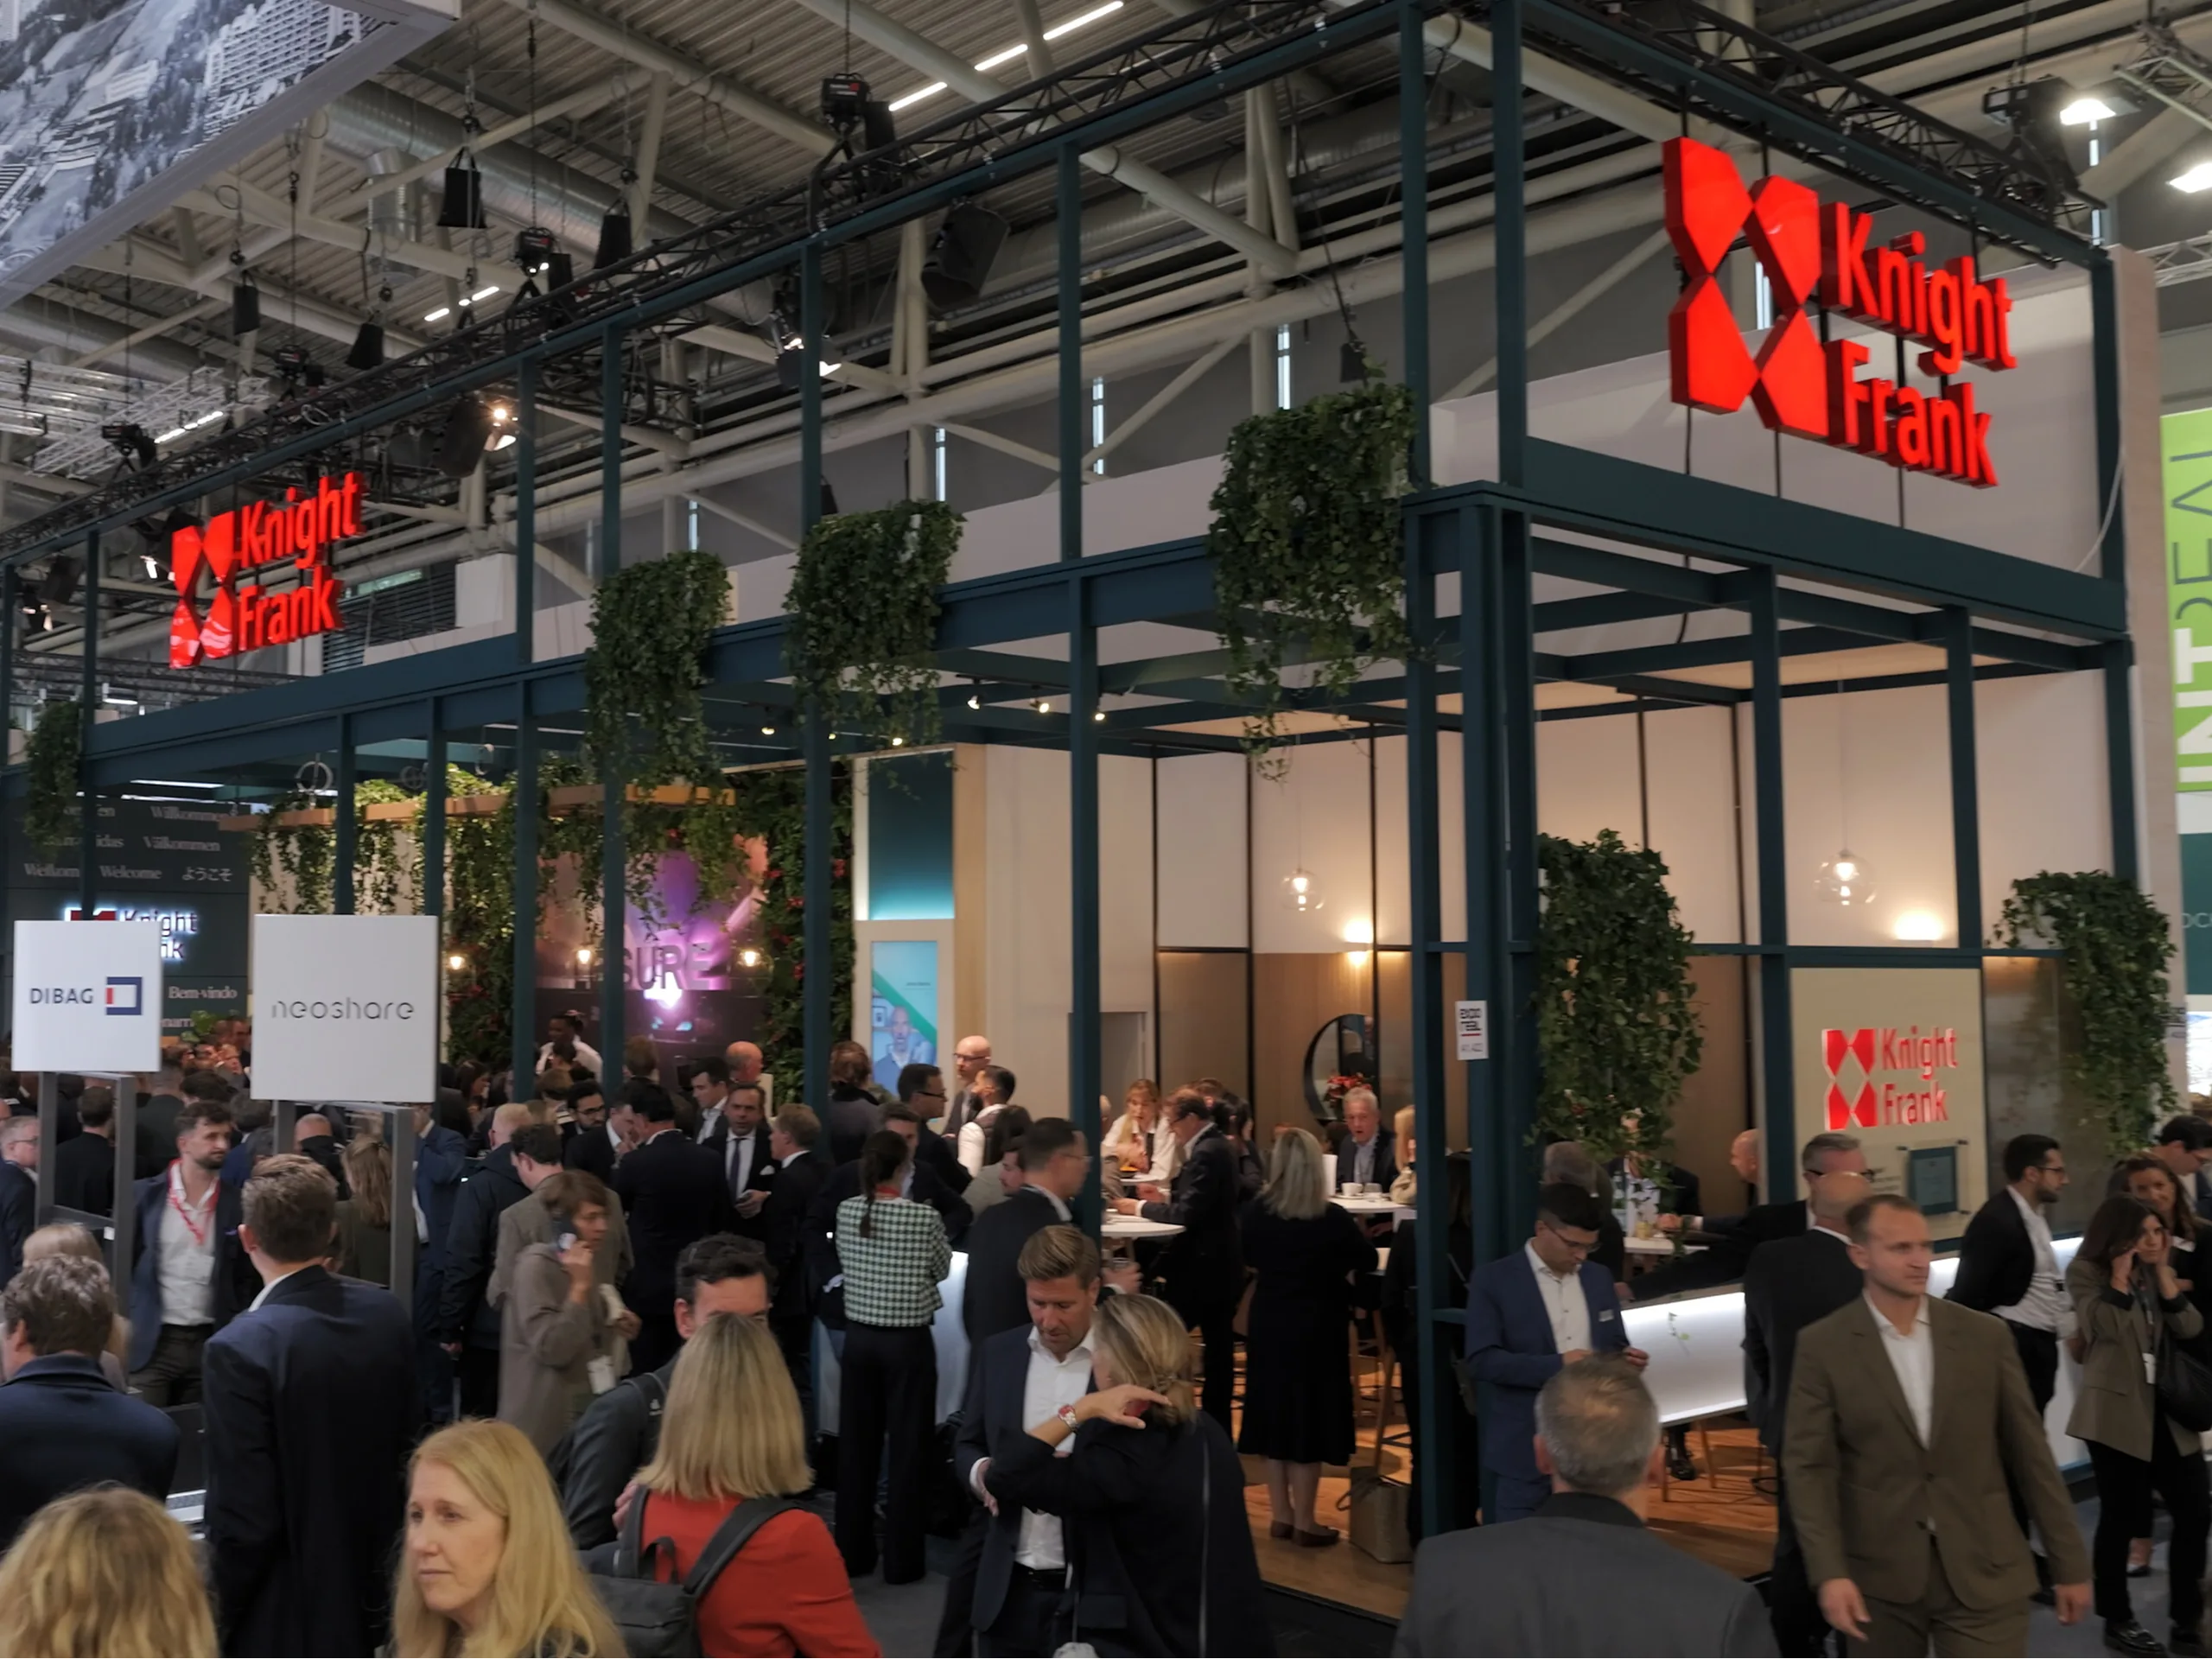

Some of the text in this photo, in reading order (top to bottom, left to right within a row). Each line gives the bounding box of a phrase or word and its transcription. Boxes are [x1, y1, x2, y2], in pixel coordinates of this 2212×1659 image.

[1825, 202, 2018, 376] Knight
[1827, 340, 1999, 488] Frank
[241, 472, 364, 569] Knight
[238, 564, 341, 651] Frank
[99, 865, 162, 880] Welcome
[181, 867, 233, 881] ようこそ
[29, 988, 94, 1004] DIBAG
[168, 986, 238, 999] Bem-vindo
[271, 996, 415, 1020] neoshare
[1878, 1026, 1958, 1080] Knight
[1882, 1082, 1948, 1126] Frank
